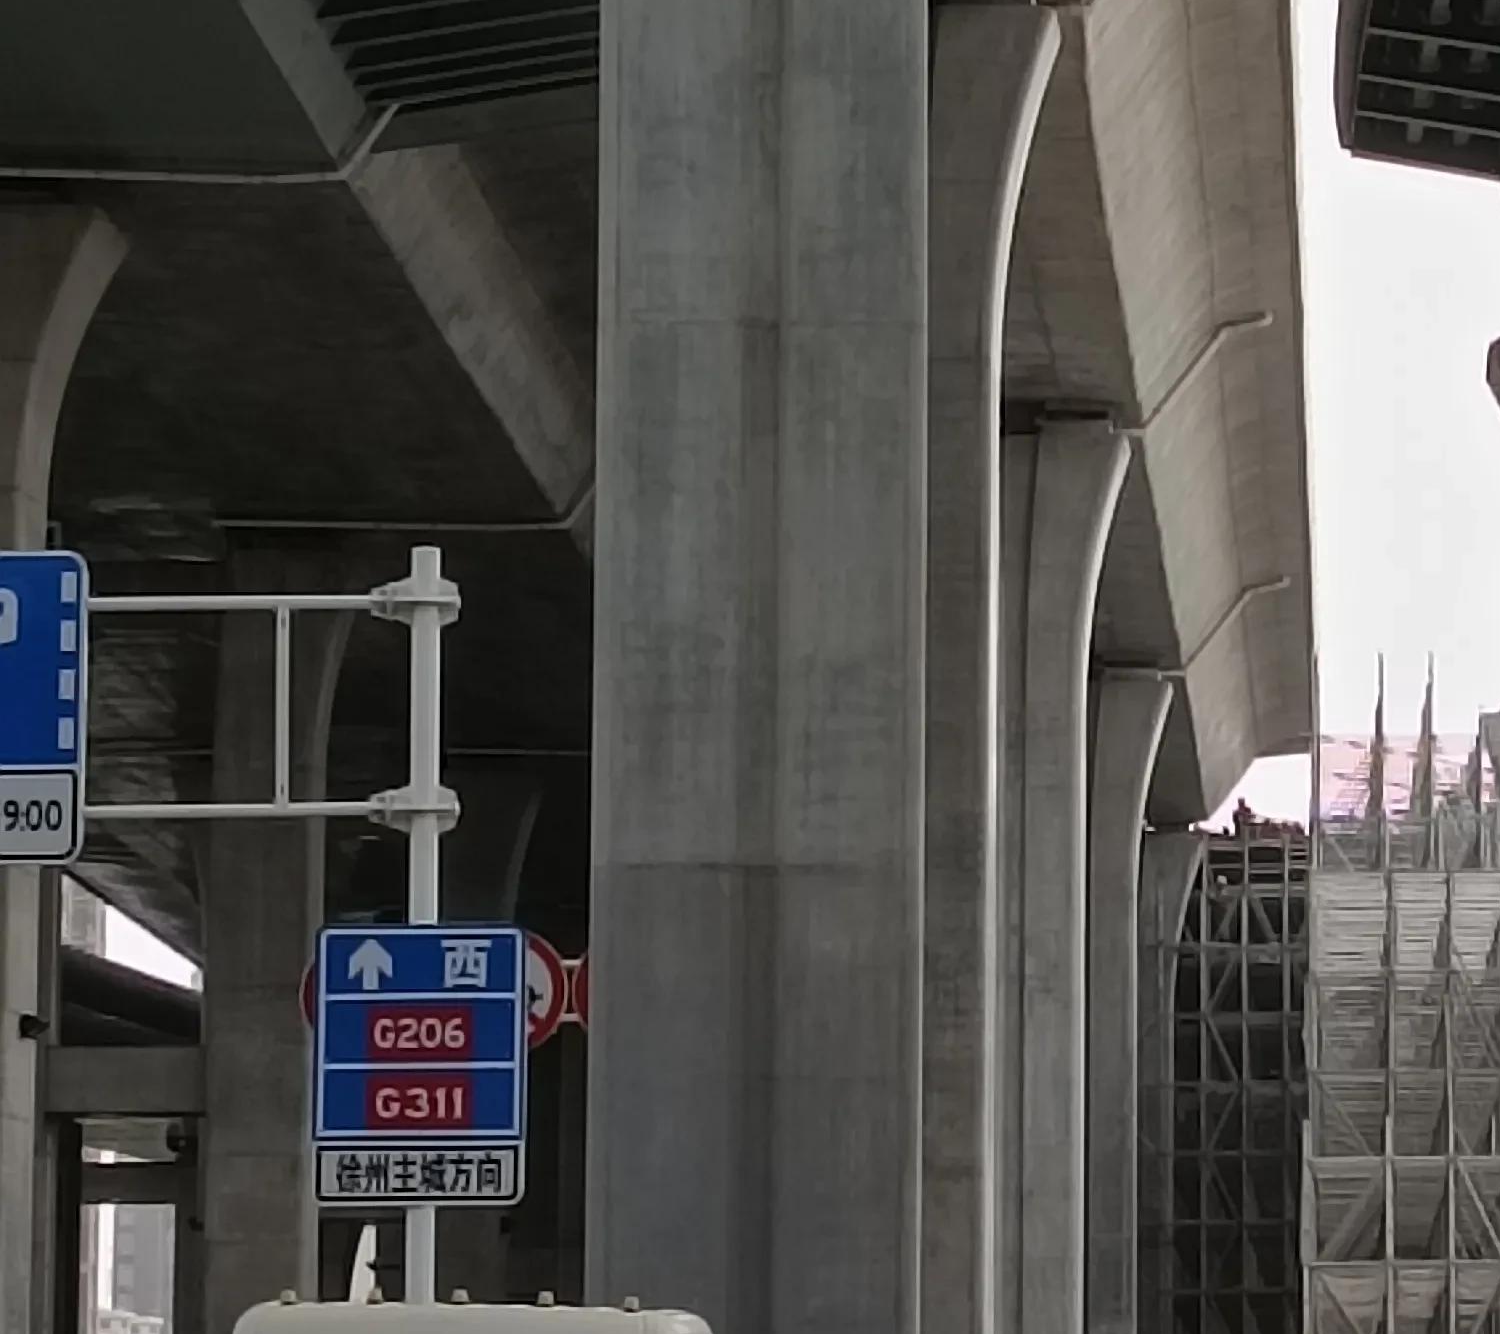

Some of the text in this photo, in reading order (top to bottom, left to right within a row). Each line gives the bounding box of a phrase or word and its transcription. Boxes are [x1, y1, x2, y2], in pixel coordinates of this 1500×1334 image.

[441, 939, 492, 988] 西
[373, 1018, 466, 1049] G206
[375, 1087, 464, 1119] G311
[336, 1153, 501, 1193] 徐州主城方向
